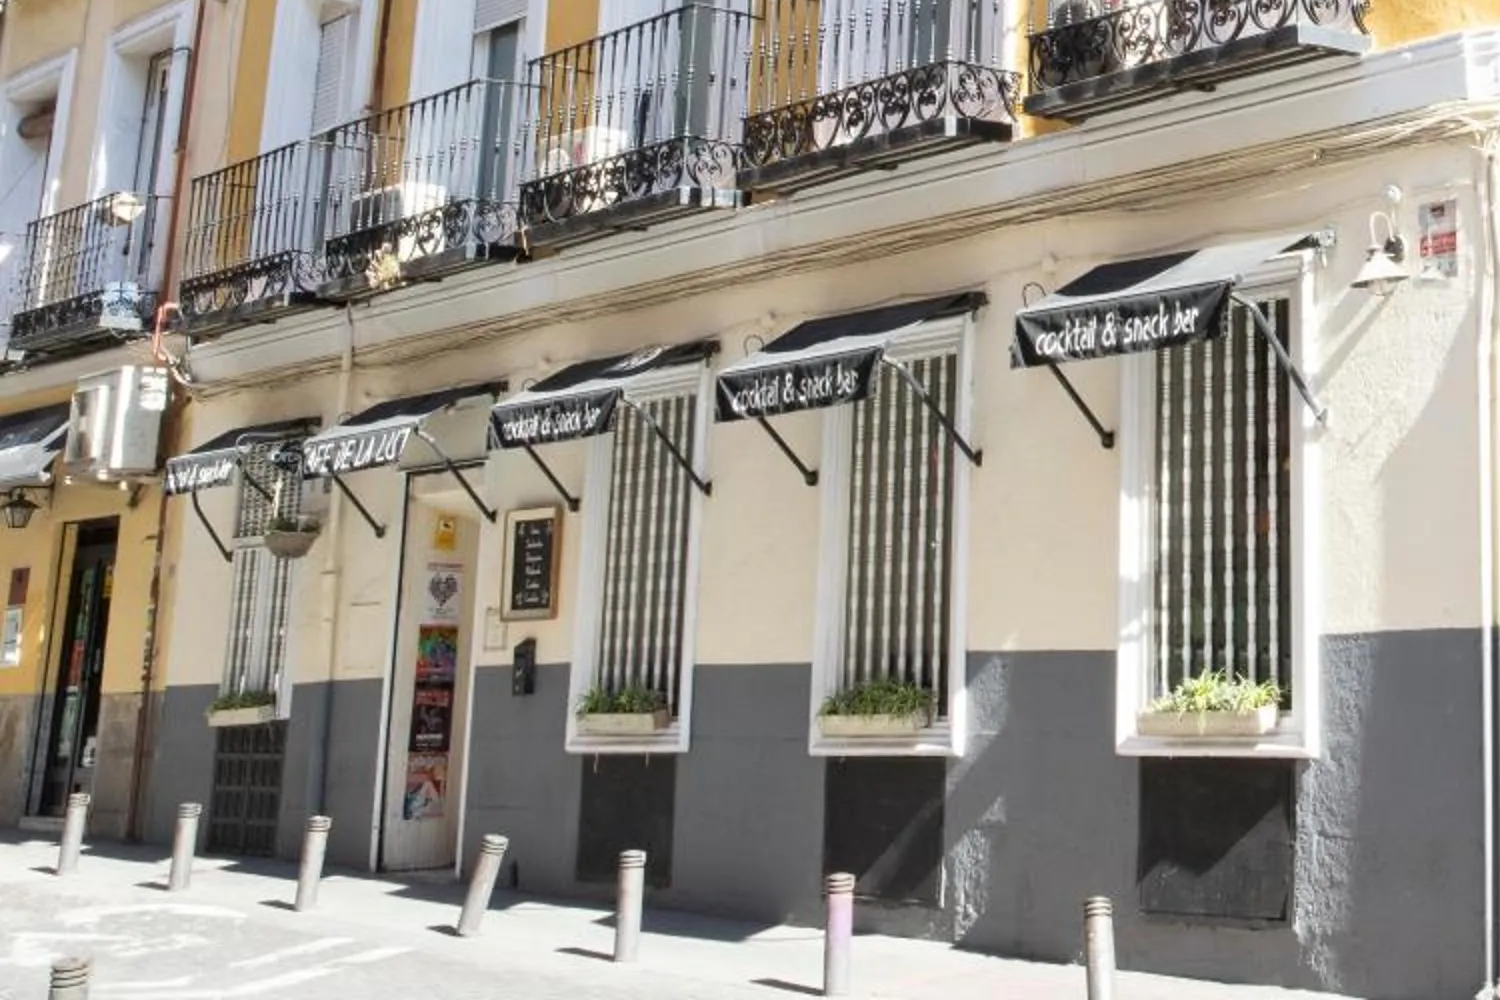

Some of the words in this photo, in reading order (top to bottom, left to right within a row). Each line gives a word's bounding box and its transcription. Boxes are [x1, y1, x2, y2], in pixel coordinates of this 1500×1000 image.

[1035, 317, 1098, 357] cocktail
[1102, 311, 1117, 348] &
[1123, 303, 1169, 344] snack
[1173, 303, 1199, 337] bar
[732, 375, 780, 412] cocktail
[783, 371, 795, 403] &
[799, 364, 833, 402] snack
[836, 363, 860, 396] bar
